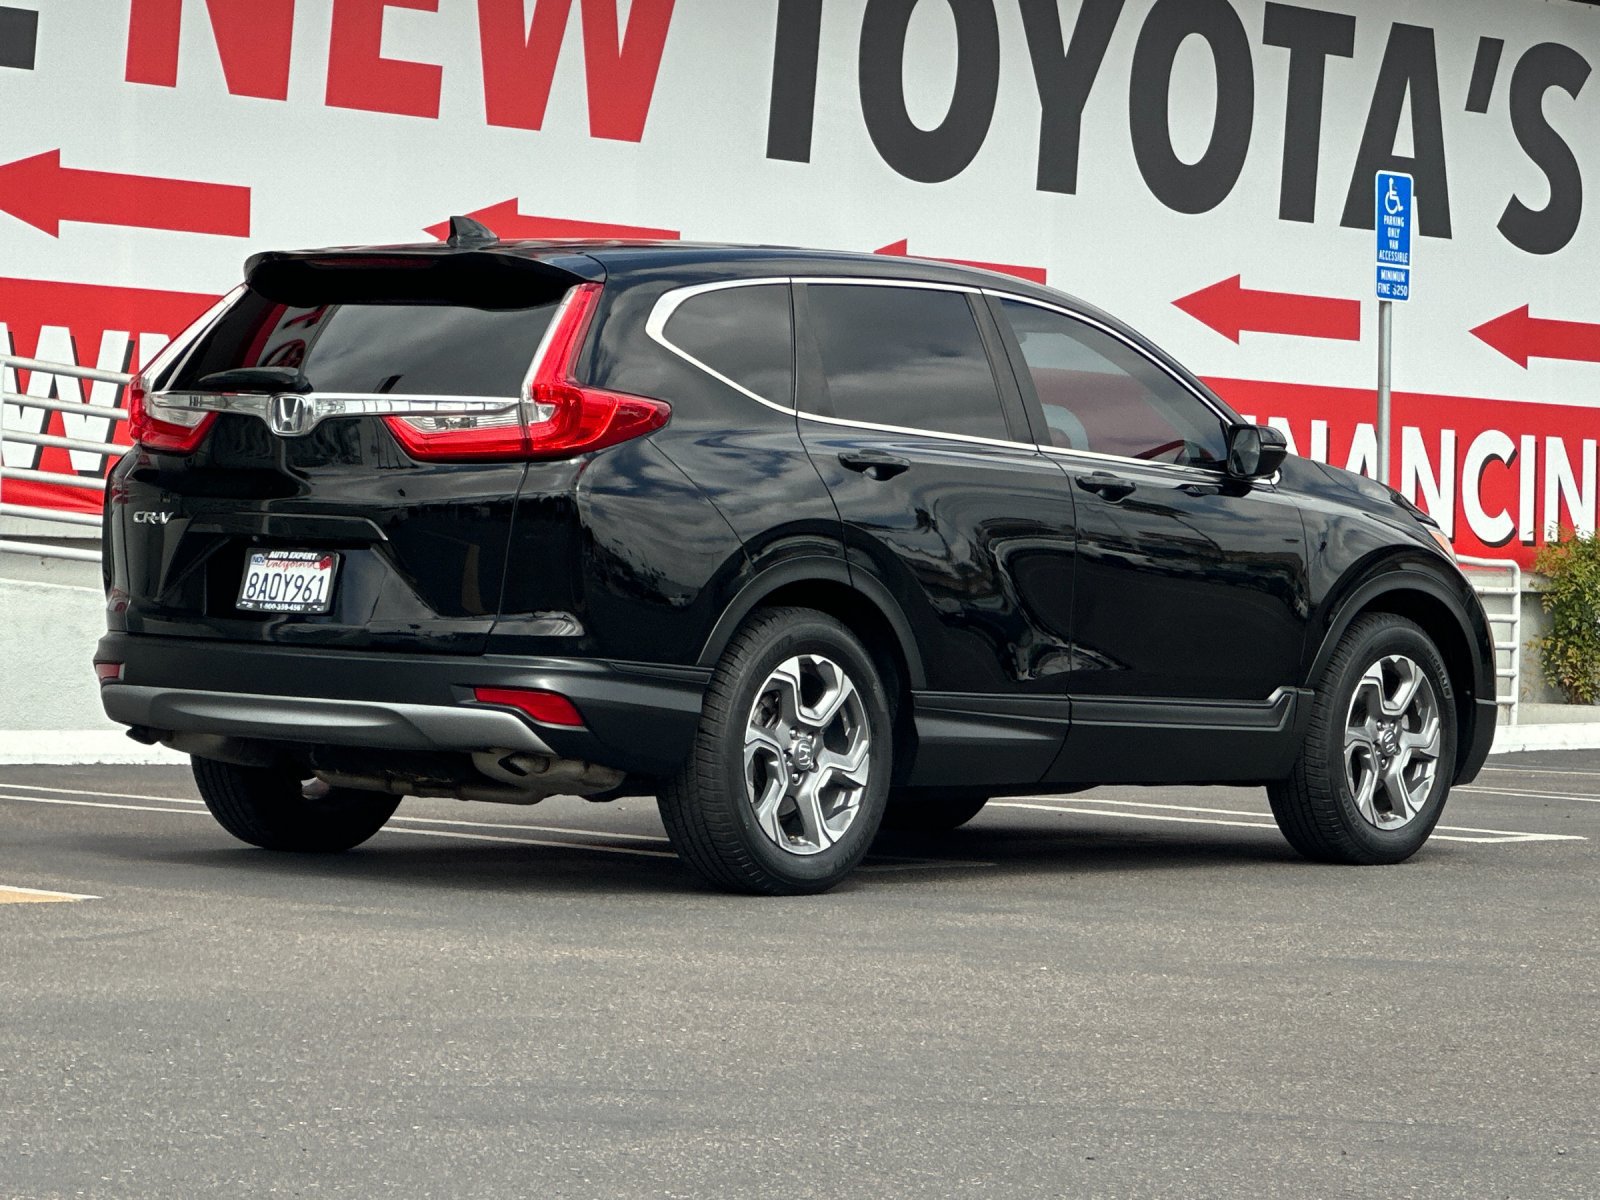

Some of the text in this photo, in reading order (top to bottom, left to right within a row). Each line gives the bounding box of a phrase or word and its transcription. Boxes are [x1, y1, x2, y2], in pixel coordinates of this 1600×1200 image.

[1383, 214, 1405, 228] PARKING
[1387, 227, 1401, 239] ONLY
[1389, 239, 1399, 250] VAN
[1379, 250, 1408, 263] ACCESSIBLE
[1380, 269, 1406, 283] MINIMUM
[1377, 283, 1408, 297] FINE $250
[133, 511, 174, 525] CR-V
[268, 551, 317, 560] AUTO EXPERT
